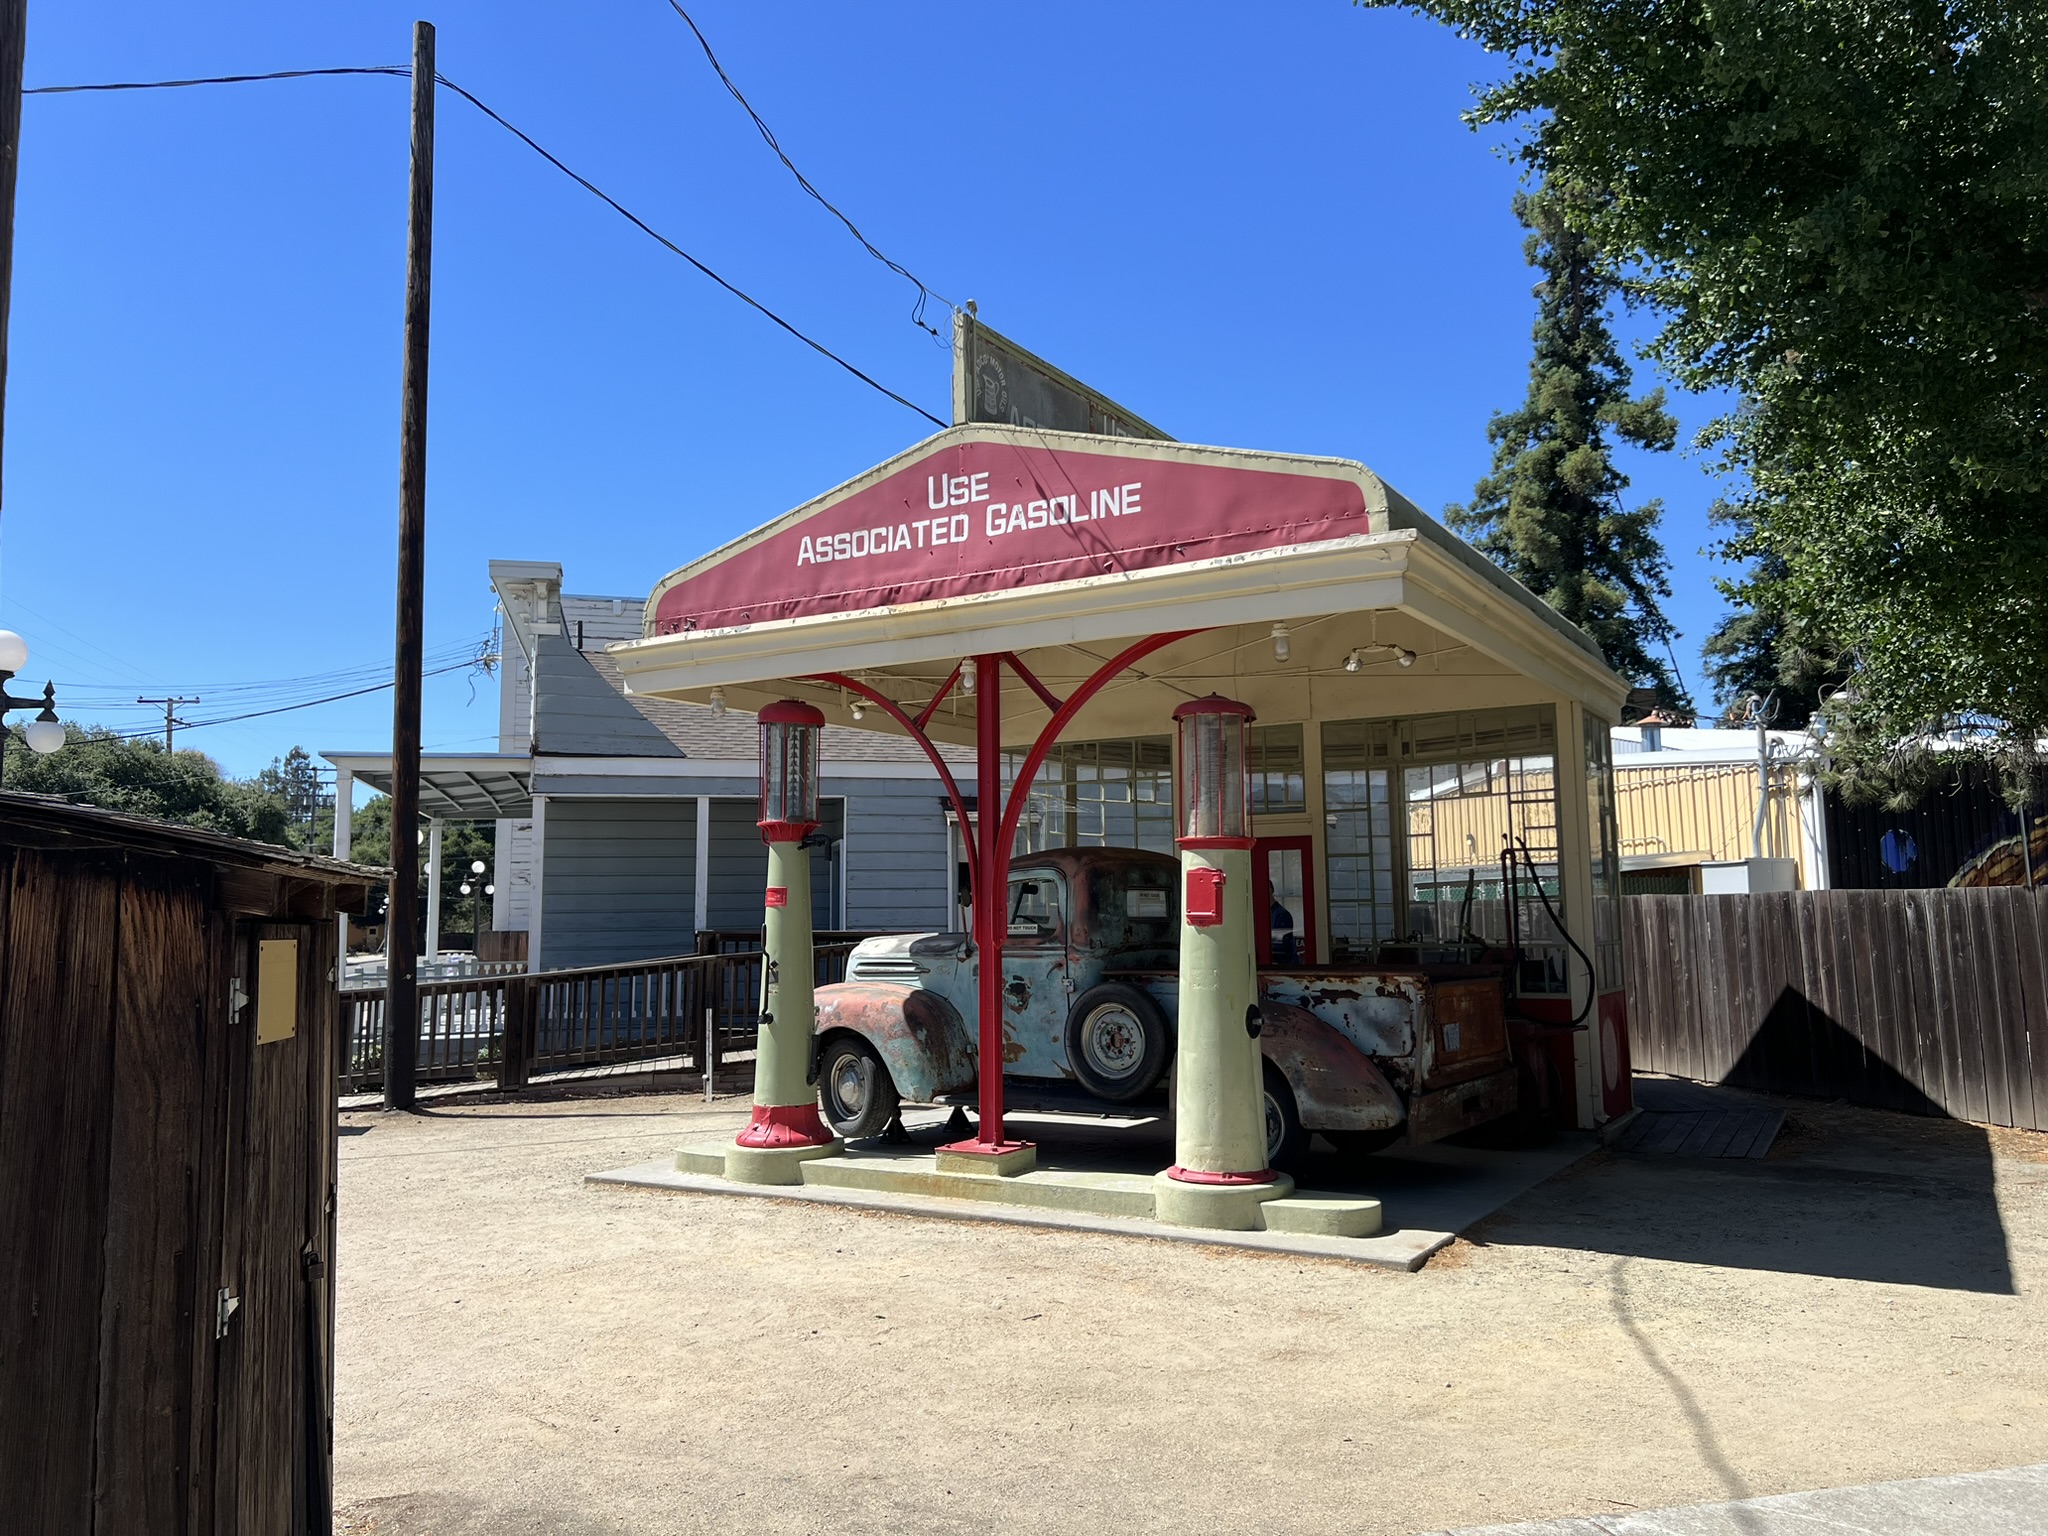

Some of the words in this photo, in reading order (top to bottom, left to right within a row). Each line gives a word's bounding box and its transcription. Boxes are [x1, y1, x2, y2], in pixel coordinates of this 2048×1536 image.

[990, 356, 1006, 387] MOTOR
[999, 391, 1007, 412] OILS
[928, 472, 989, 510] USE
[797, 514, 969, 566] ASSOCIATED
[986, 482, 1142, 537] GASOLINE
